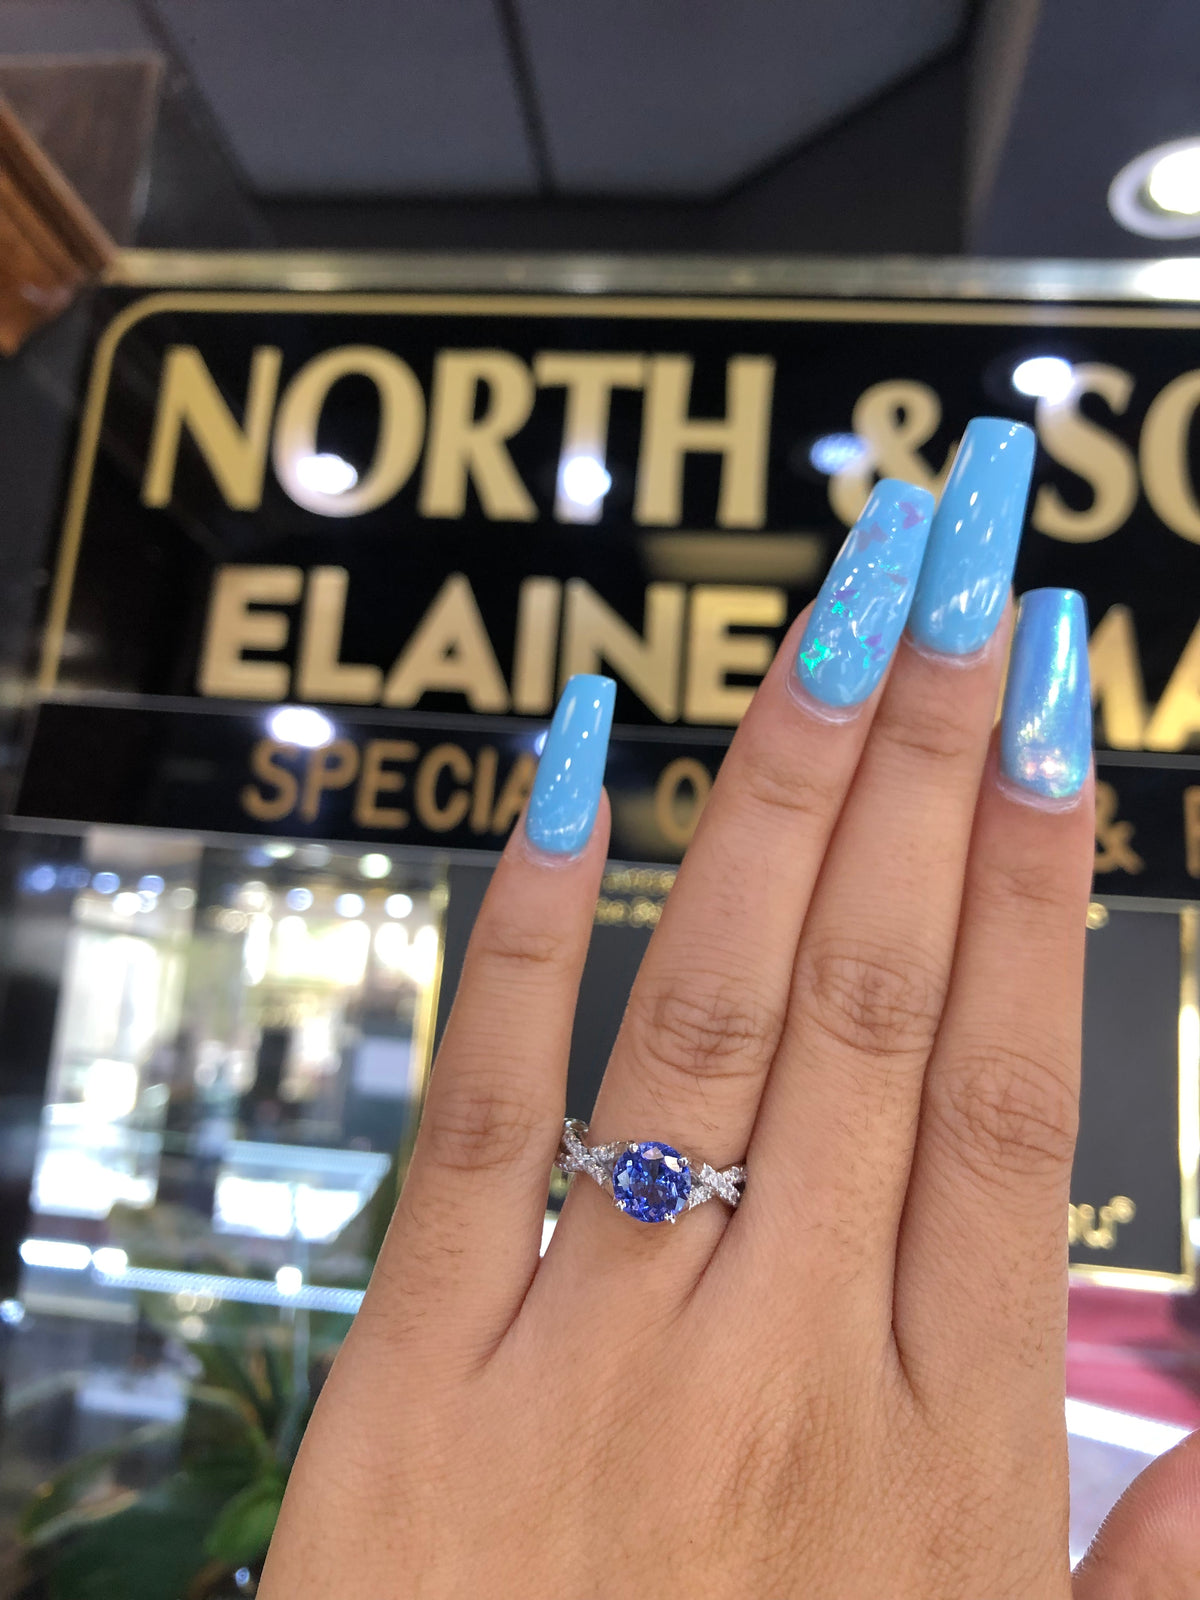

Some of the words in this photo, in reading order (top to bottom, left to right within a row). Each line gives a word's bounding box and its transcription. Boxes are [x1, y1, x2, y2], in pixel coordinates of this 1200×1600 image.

[142, 344, 776, 528] NORTH
[827, 378, 960, 530] &
[197, 564, 788, 725] ELAINE
[240, 738, 540, 836] SPECIA
